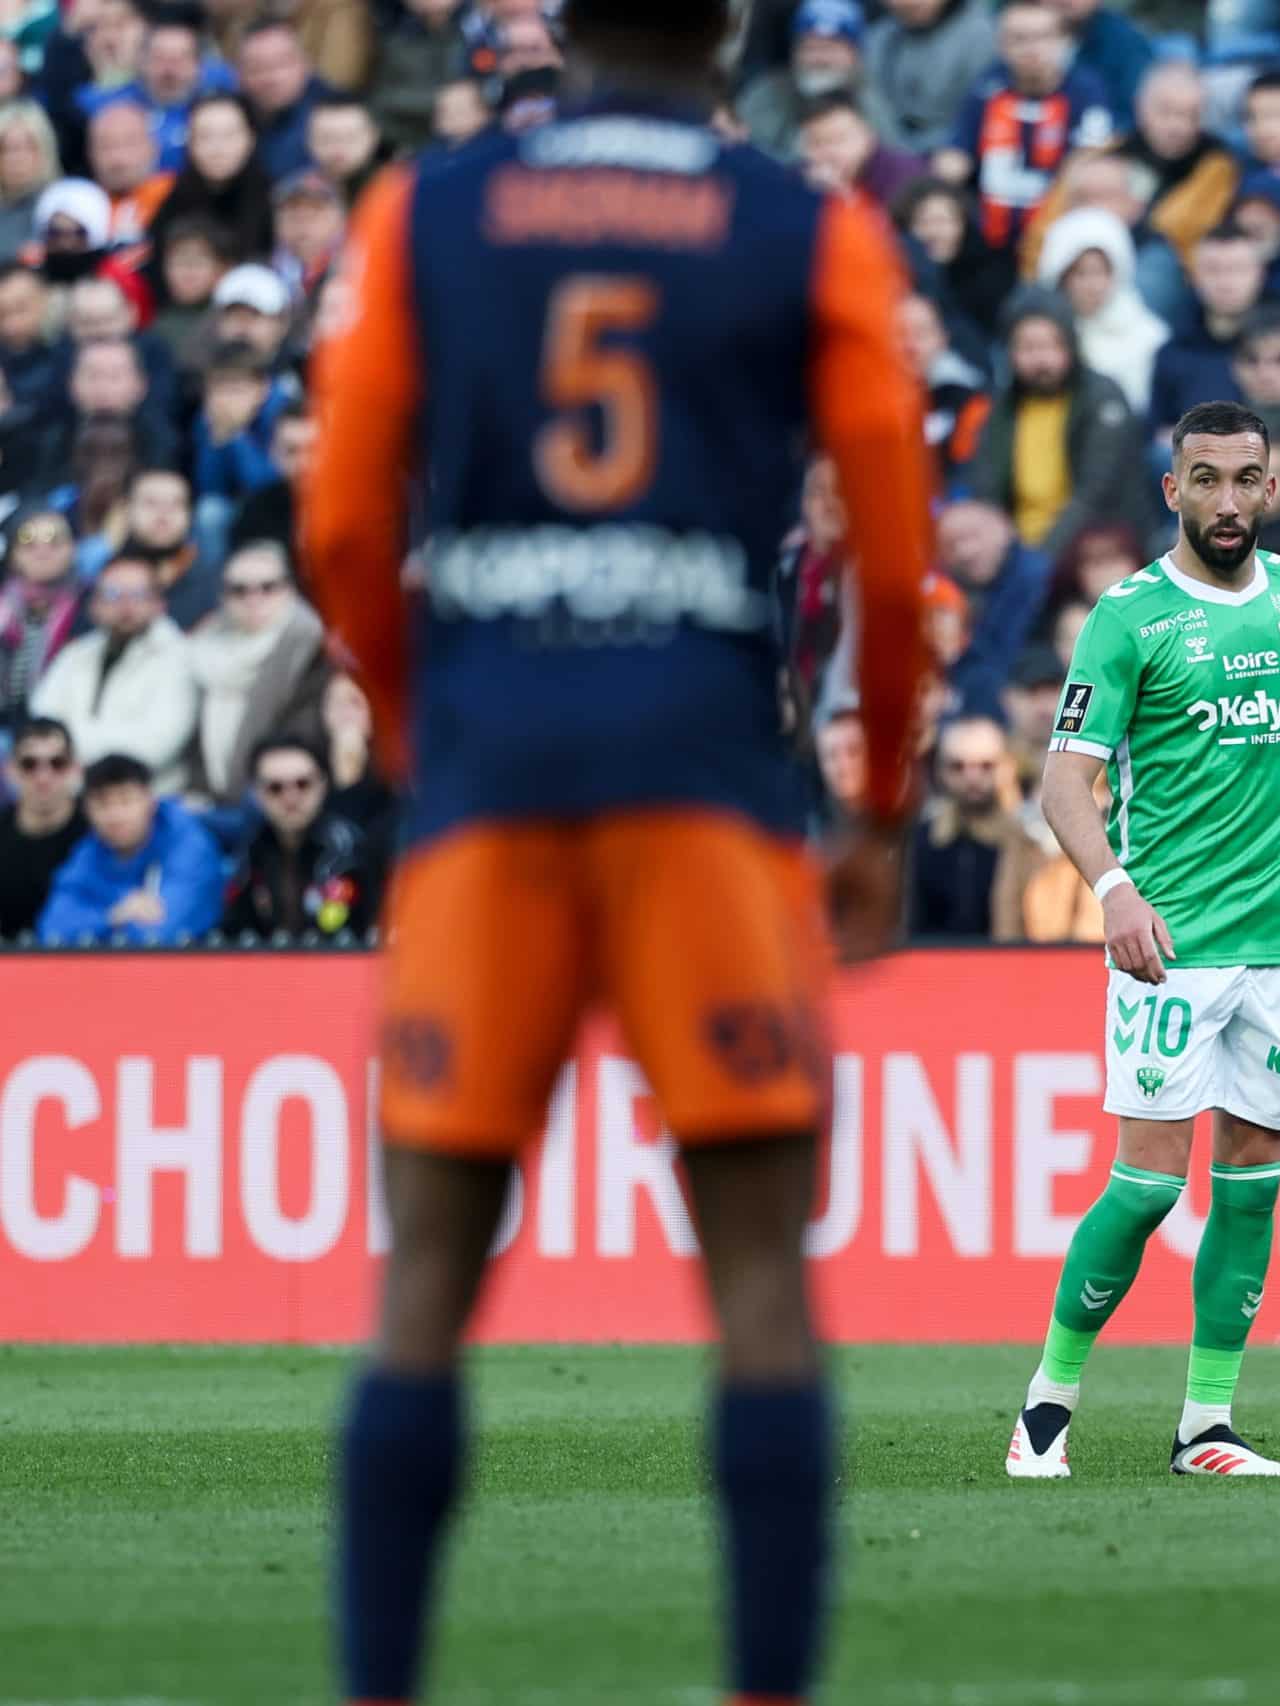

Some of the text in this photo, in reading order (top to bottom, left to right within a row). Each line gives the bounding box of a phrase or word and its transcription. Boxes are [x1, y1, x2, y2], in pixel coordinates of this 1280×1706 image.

[532, 272, 664, 515] 5
[1222, 650, 1279, 672] Loire
[1141, 995, 1193, 1059] 10
[0, 1052, 702, 1261] CHOIR
